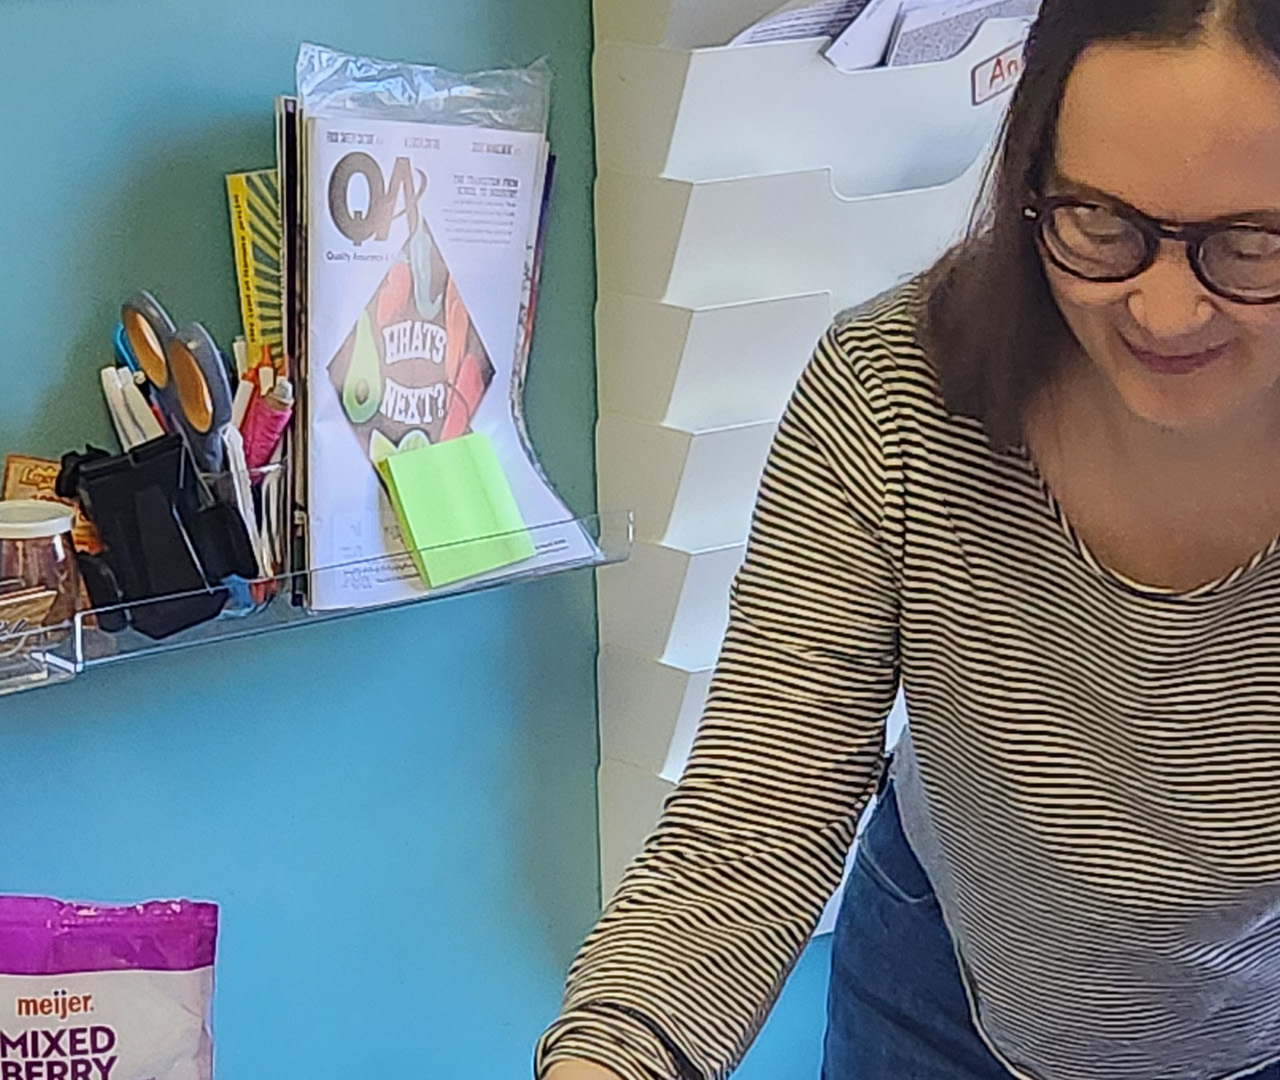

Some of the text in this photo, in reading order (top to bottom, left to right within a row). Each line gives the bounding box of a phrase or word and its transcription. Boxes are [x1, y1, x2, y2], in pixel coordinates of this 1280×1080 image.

[326, 251, 351, 263] Quality
[379, 377, 446, 425] NEXT?
[0, 1025, 117, 1059] MIXED
